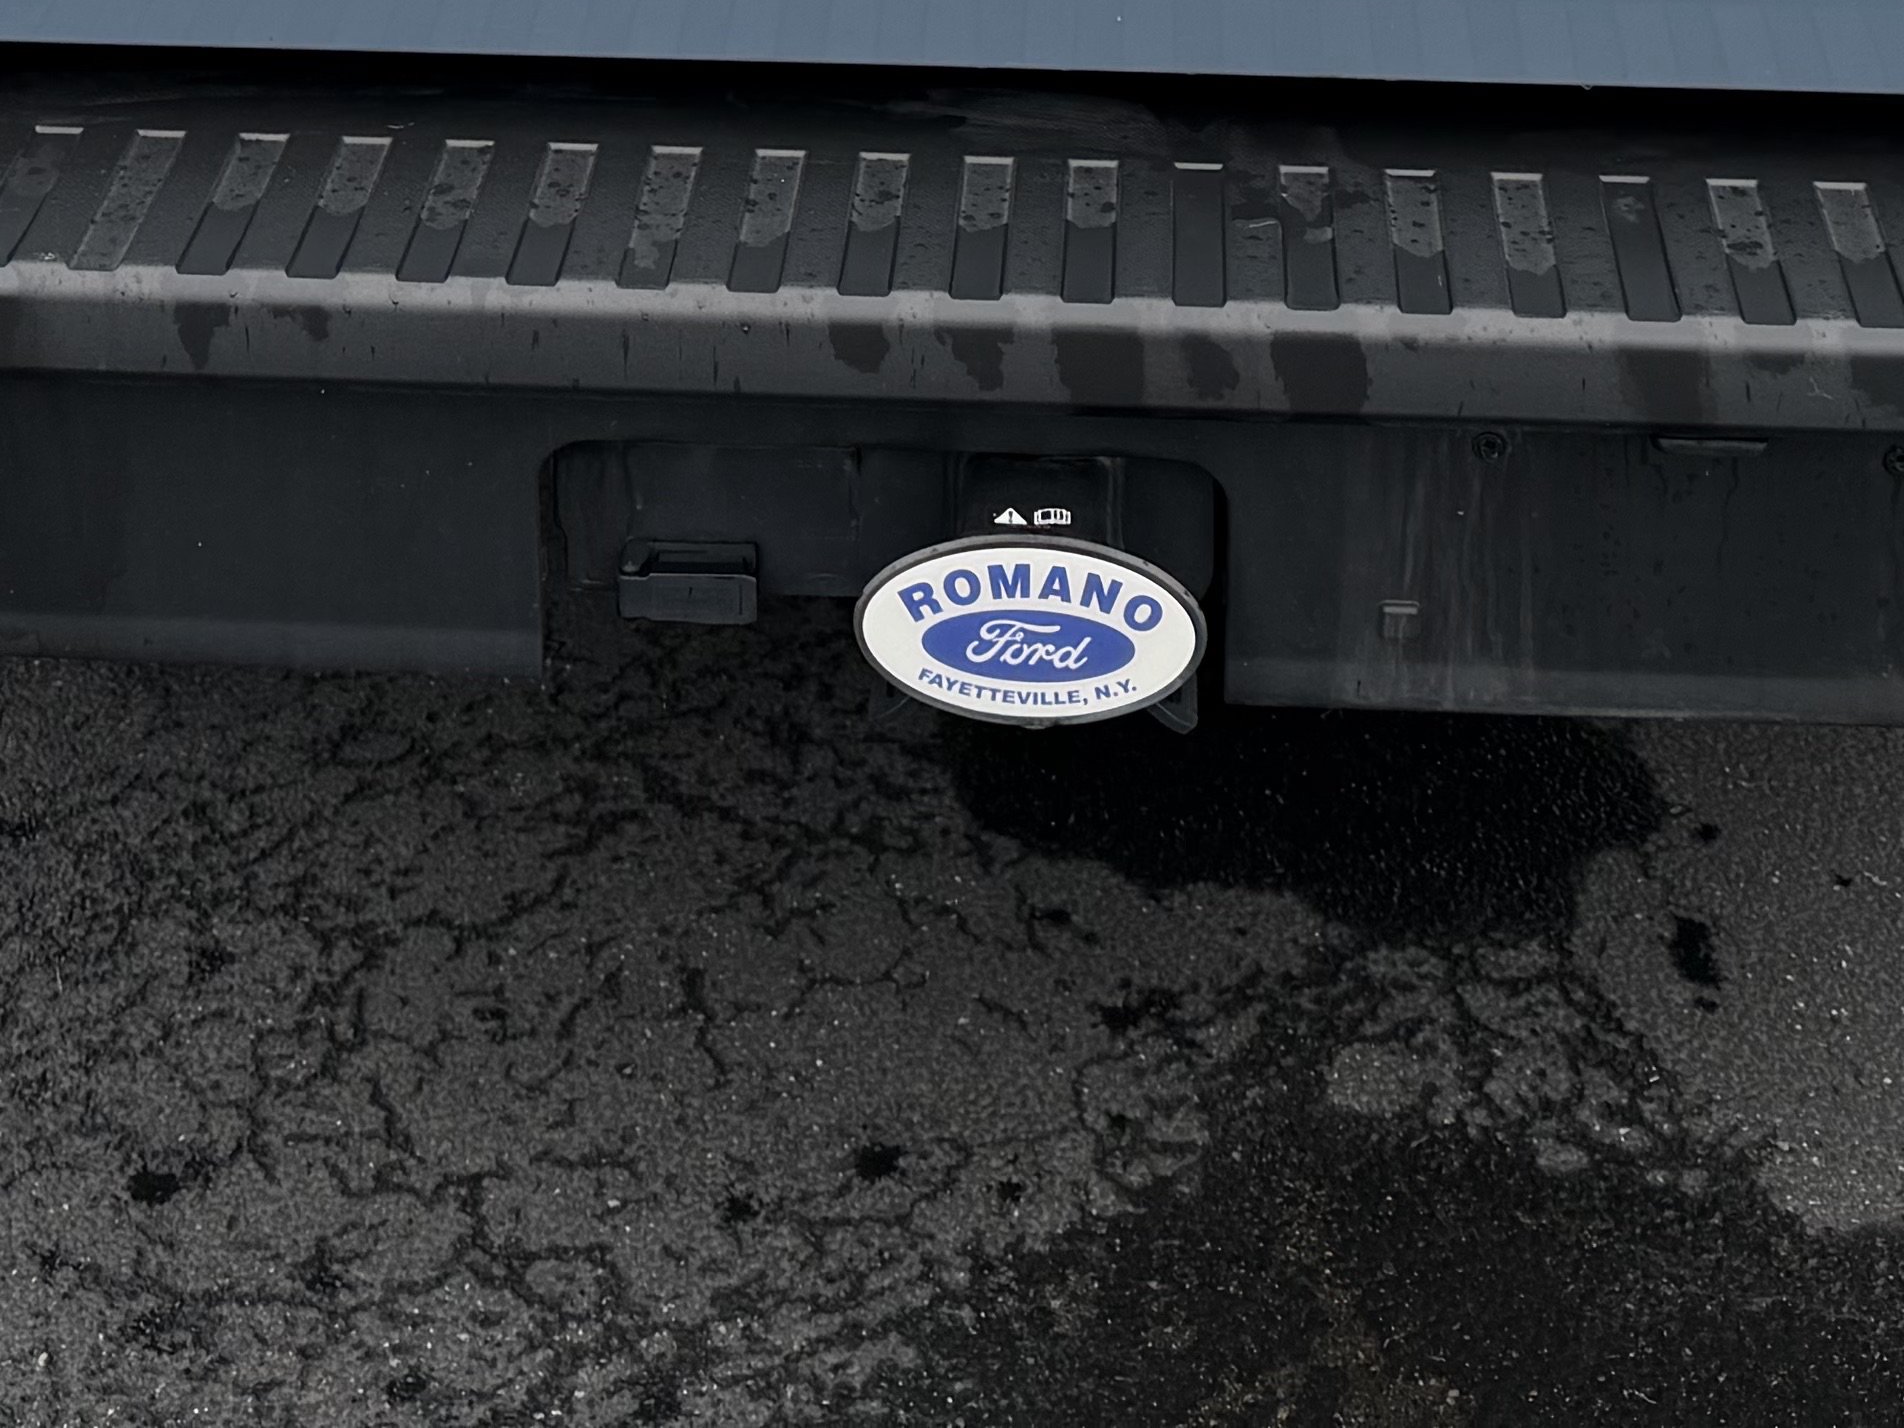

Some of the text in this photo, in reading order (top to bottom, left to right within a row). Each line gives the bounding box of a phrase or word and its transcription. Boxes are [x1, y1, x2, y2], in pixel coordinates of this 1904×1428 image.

[897, 563, 1163, 632] ROMANO
[965, 618, 1092, 671] Ford
[918, 667, 1138, 706] FAYETTEVILLE, N.Y.
